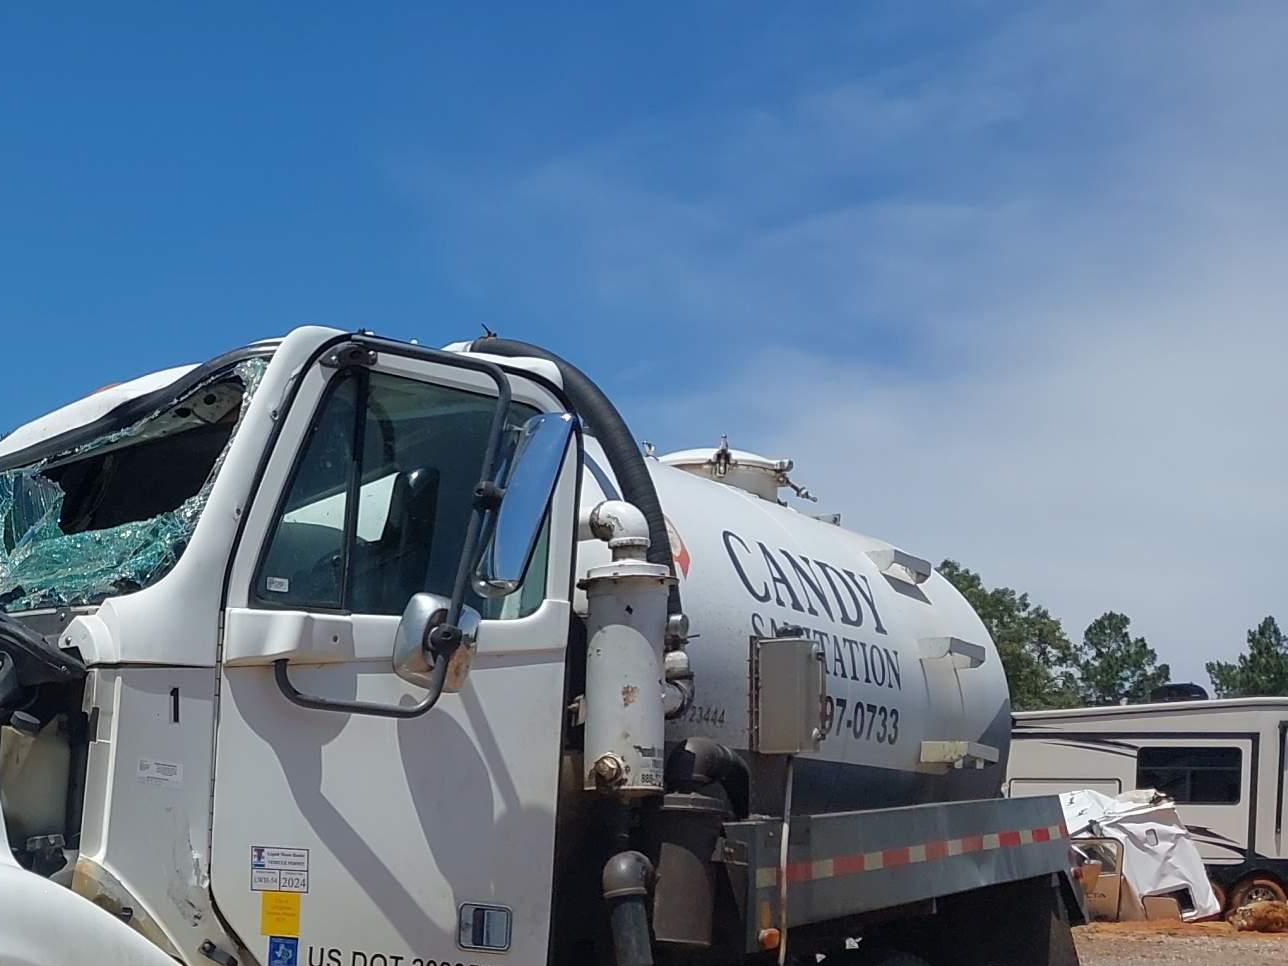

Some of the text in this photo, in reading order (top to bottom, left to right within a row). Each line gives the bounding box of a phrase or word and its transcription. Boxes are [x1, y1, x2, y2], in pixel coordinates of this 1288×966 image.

[722, 530, 888, 635] CANDY
[170, 687, 179, 723] 1
[281, 876, 306, 889] 2024
